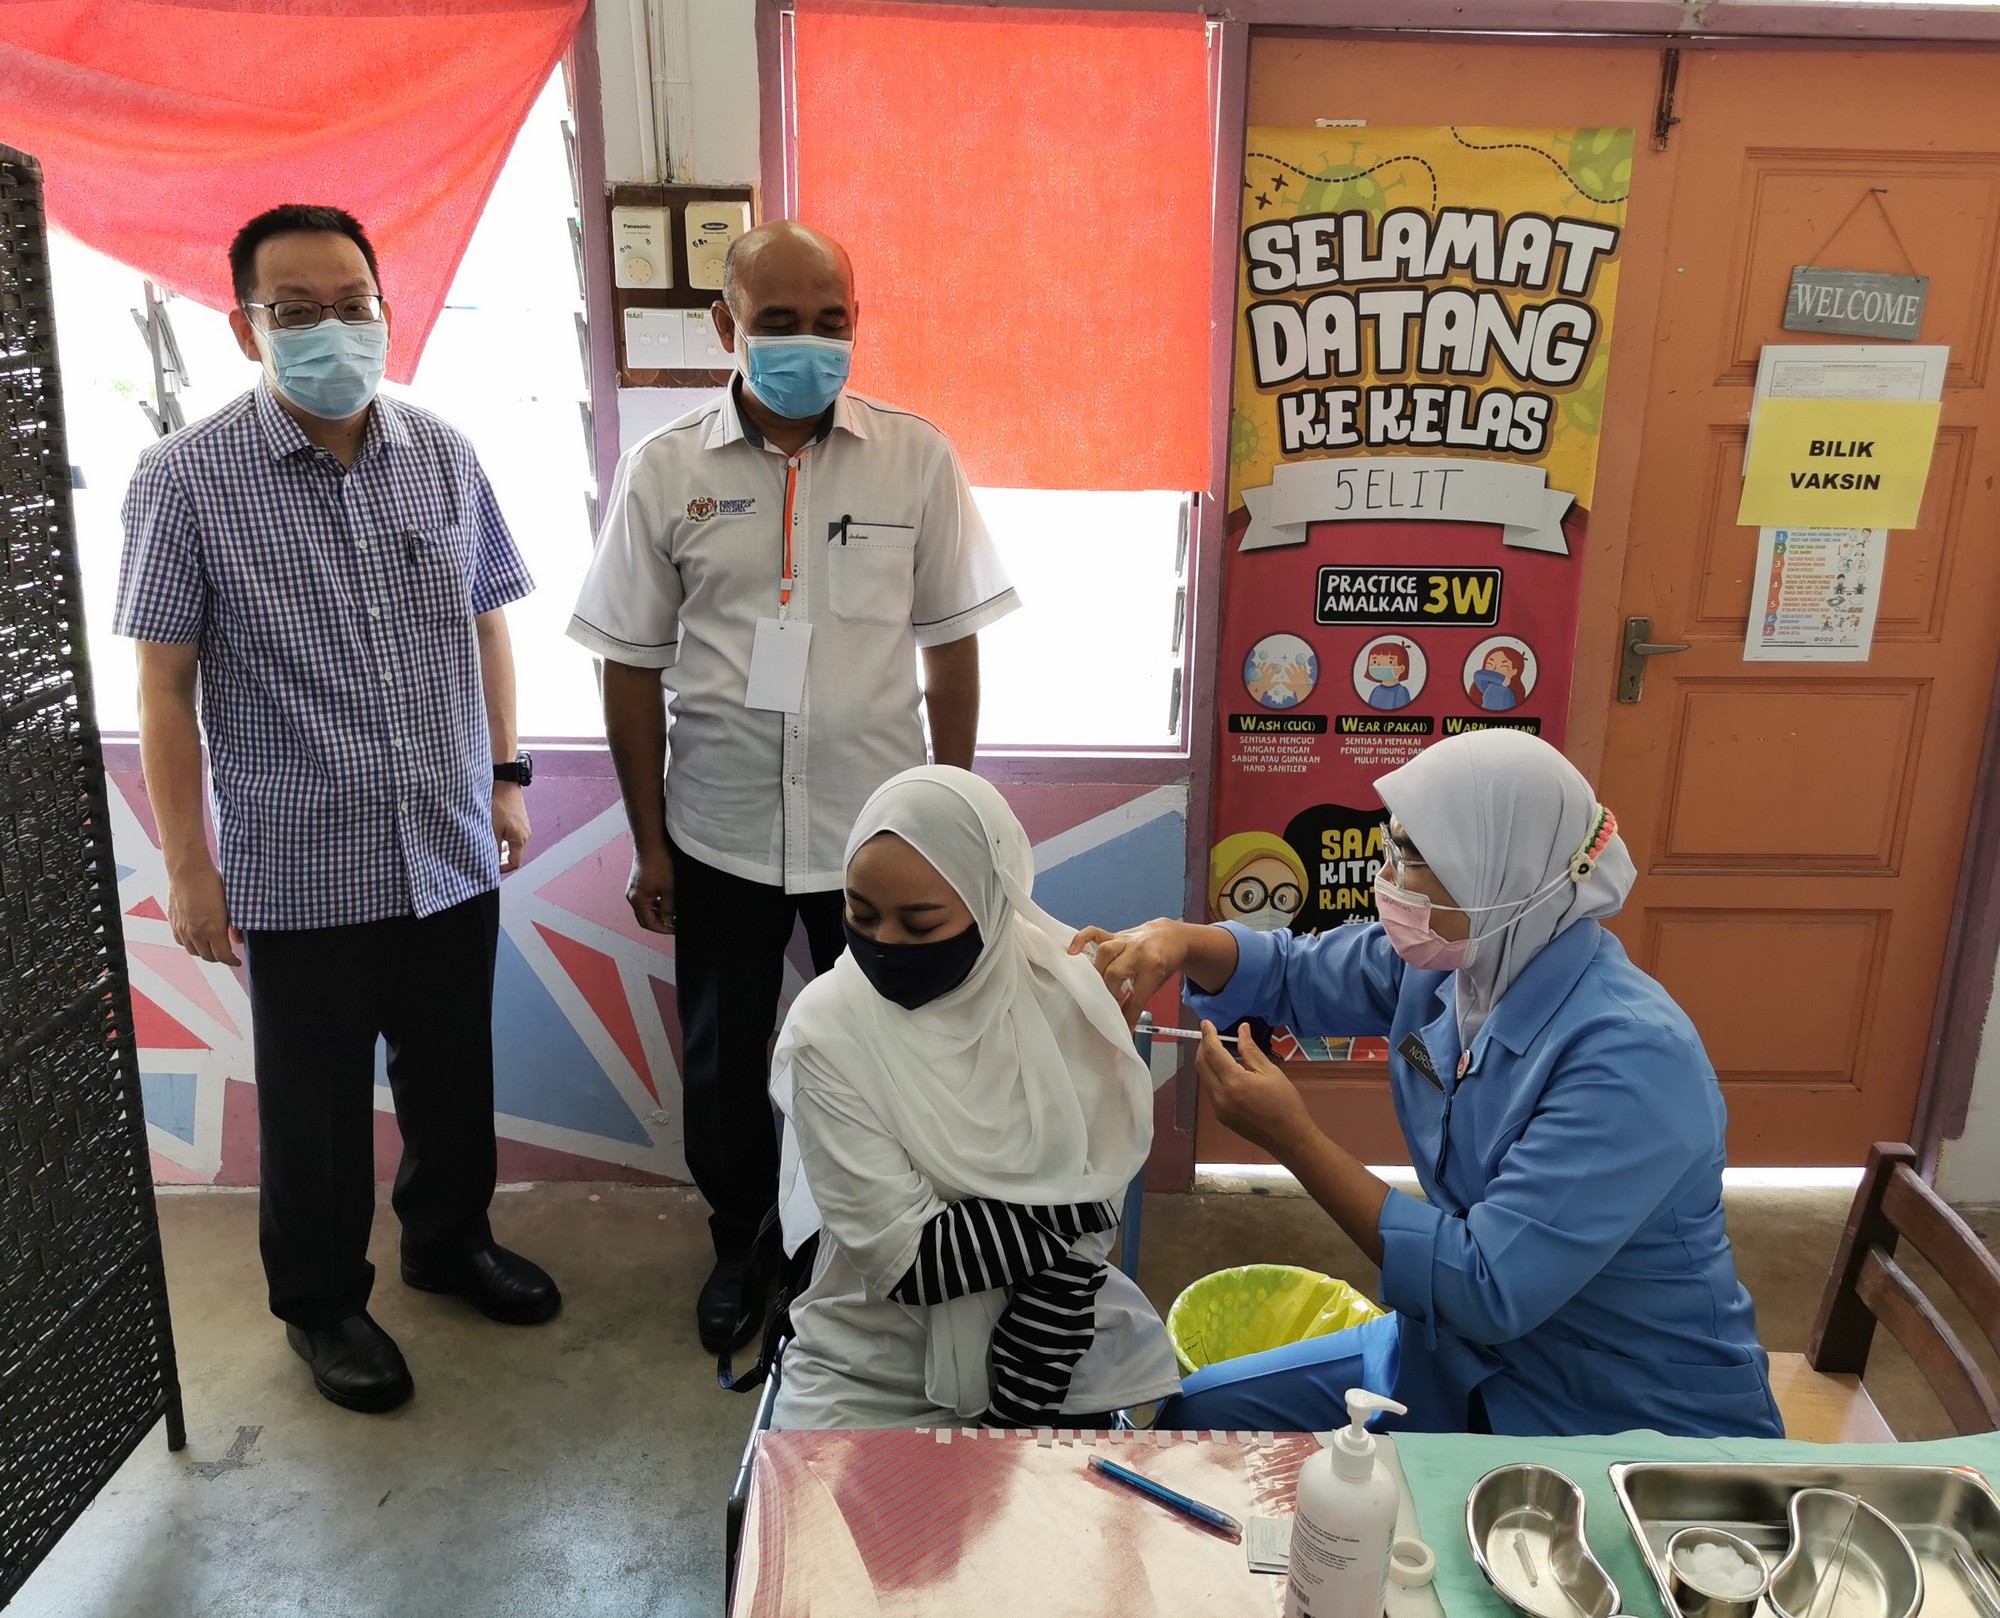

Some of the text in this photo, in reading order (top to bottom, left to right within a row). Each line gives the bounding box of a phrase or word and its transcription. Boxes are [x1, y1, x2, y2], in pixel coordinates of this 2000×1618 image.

[1247, 210, 1616, 295] SELAMAT
[1795, 283, 1920, 326] WELCOME
[1248, 289, 1594, 386] DATANG
[1281, 388, 1550, 452] KE KELAS
[1808, 440, 1875, 458] BILIK
[1790, 472, 1881, 490] VAKSIN
[1776, 545, 1783, 554] 2
[1326, 575, 1417, 594] PRACTICE
[1423, 575, 1494, 614] 3W
[1324, 595, 1419, 613] AMALKAN
[1283, 720, 1316, 732] (CUCI)
[1383, 721, 1428, 734] (PAKAI)
[1239, 735, 1315, 745] SENTIASA MENCUCI
[1344, 737, 1422, 746] SENTIASA MEMAKAI
[1243, 745, 1310, 754] TANGAN DENGAN
[1340, 746, 1375, 755] PENUTUP
[1376, 747, 1407, 756] HIDUNG
[1231, 755, 1320, 764] SABUN ATAU GUNAKAN
[1354, 756, 1379, 764] MULUT
[1243, 764, 1307, 773] HAND SANITIZER
[1319, 859, 1382, 885] KITA
